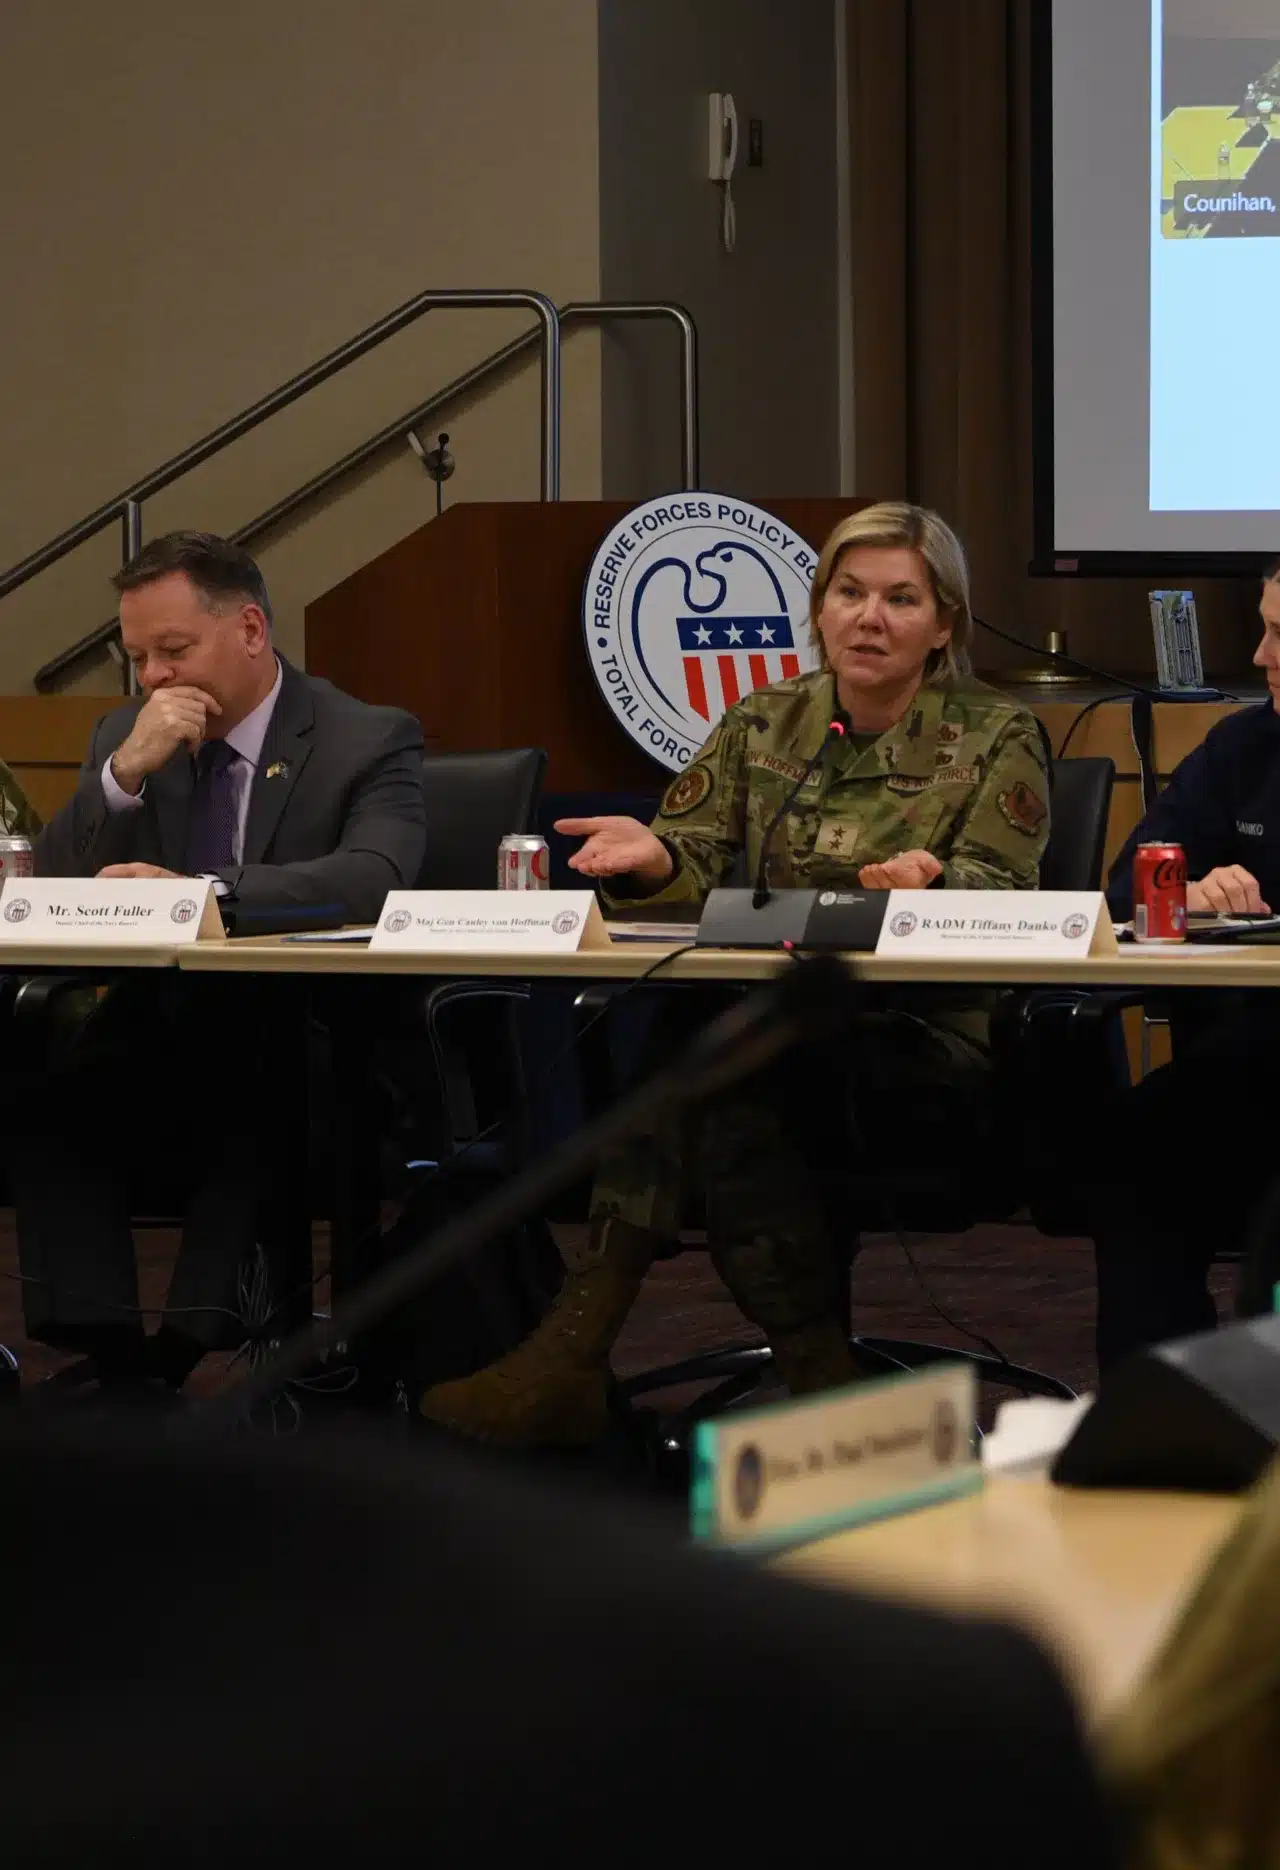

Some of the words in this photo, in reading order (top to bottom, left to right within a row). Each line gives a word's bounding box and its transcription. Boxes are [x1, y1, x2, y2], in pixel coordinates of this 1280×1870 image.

[1183, 192, 1277, 214] Counihan,
[594, 533, 636, 629] RESERVE
[631, 501, 712, 540] FORCES
[717, 503, 795, 551] POLICY
[601, 654, 643, 722] TOTAL
[638, 720, 697, 765] FORC
[47, 904, 71, 917] Mr.
[75, 904, 109, 917] Scott
[114, 904, 155, 917] Fuller
[415, 917, 433, 928] Maj
[510, 917, 550, 926] Hoffman
[921, 918, 965, 930] RADM
[971, 918, 1012, 932] Tiffany
[1018, 920, 1058, 932] Danko
